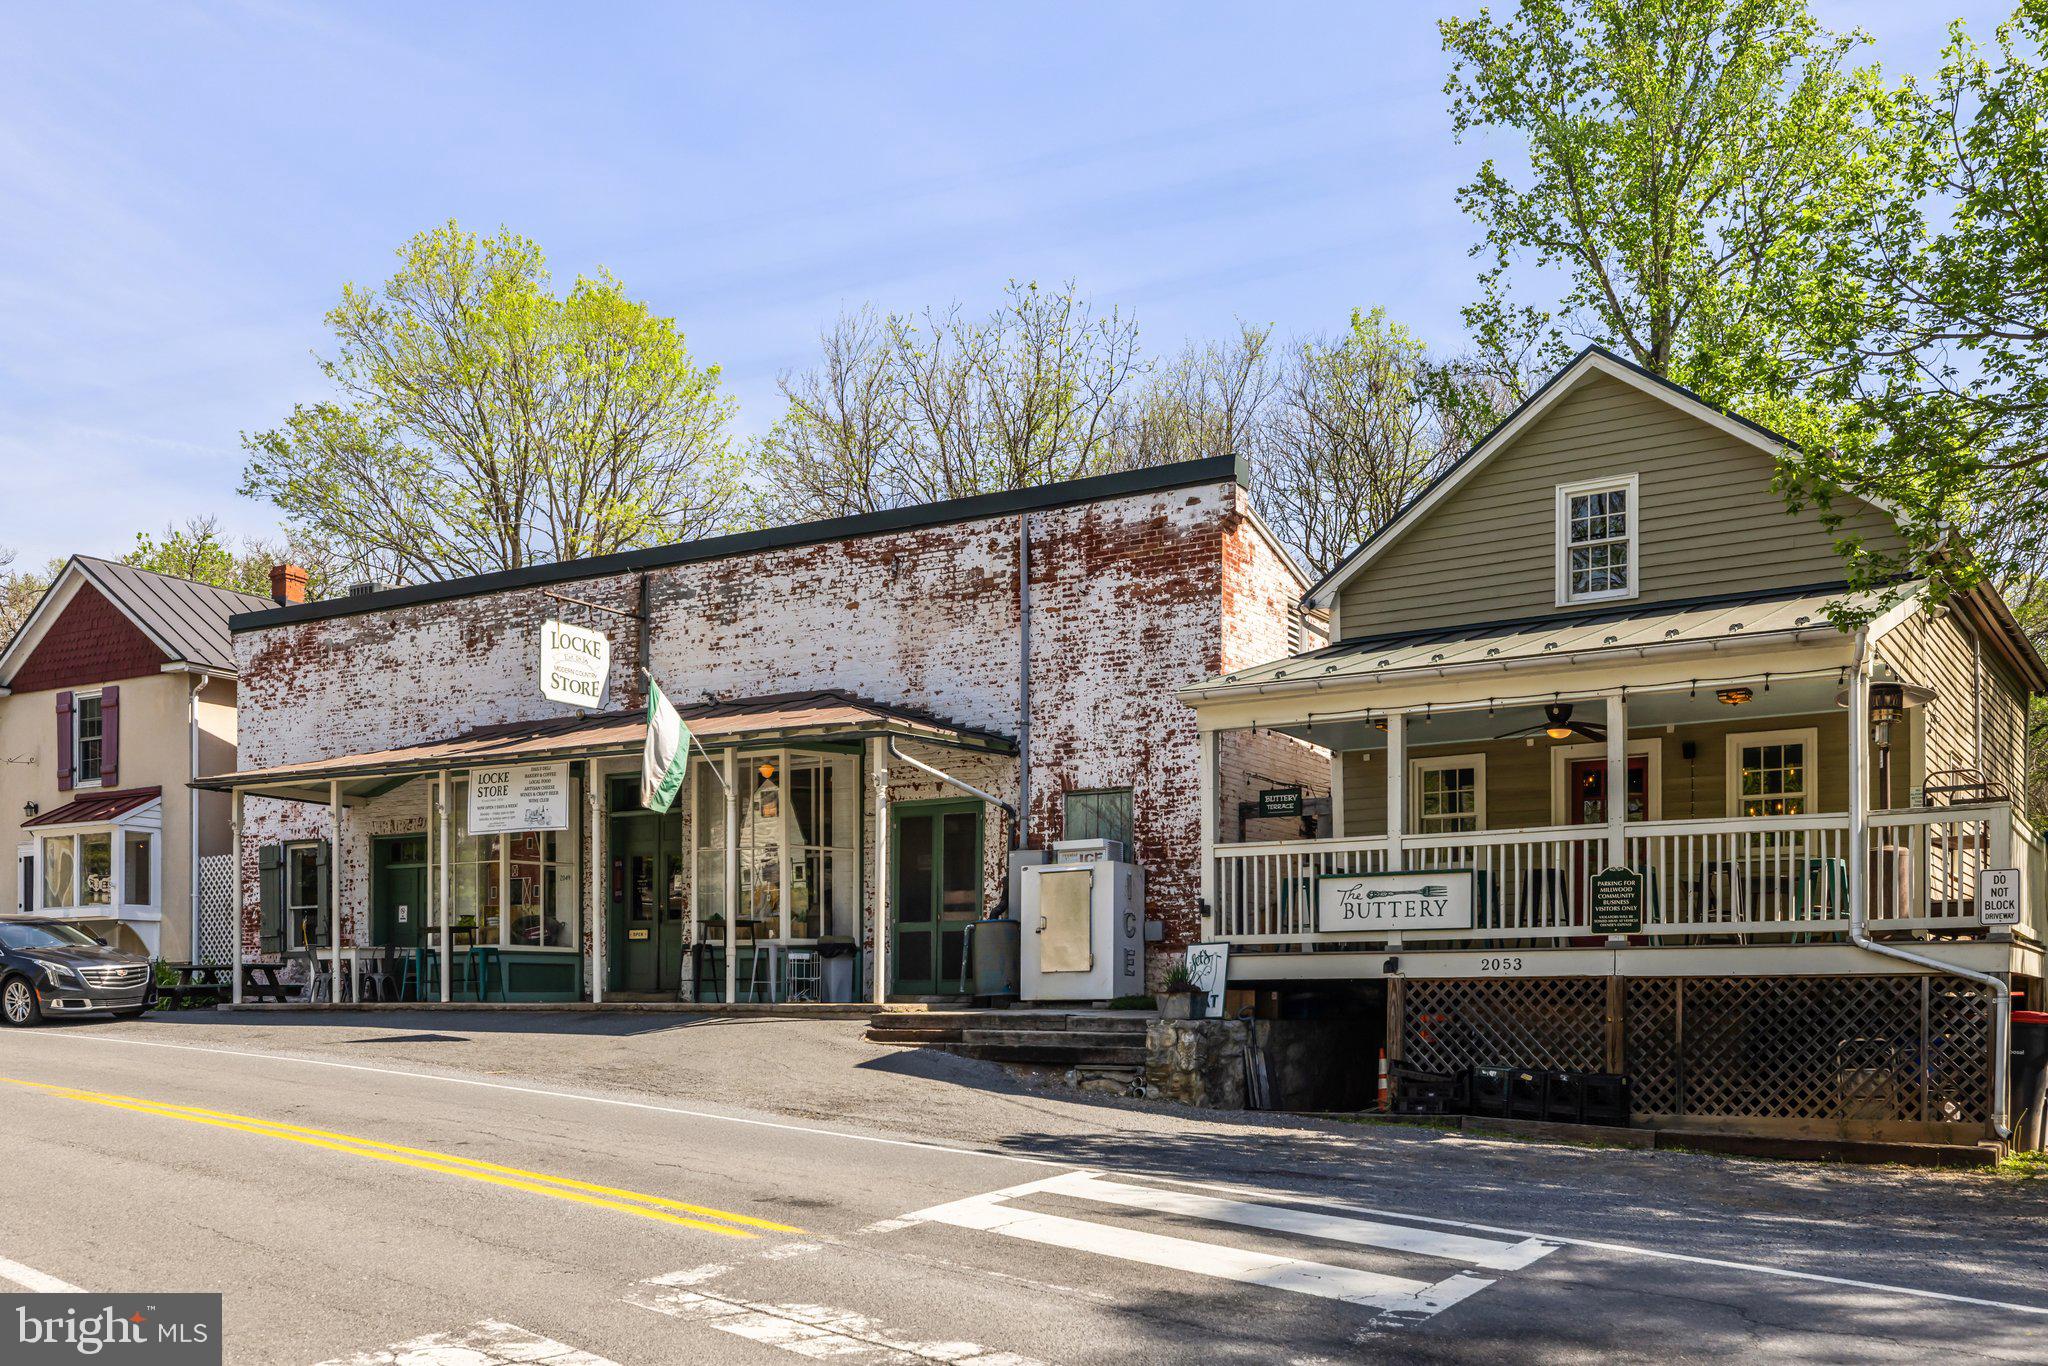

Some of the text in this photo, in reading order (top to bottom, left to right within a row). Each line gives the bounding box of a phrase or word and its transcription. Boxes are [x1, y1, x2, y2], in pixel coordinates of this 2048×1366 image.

[551, 631, 601, 660] LOCKE
[551, 672, 600, 697] STORE
[478, 772, 510, 784] LOCKE
[478, 785, 509, 797] STORE
[1265, 794, 1298, 802] BUTTERY
[1993, 875, 2006, 884] DO
[1337, 883, 1364, 906] The
[1991, 887, 2008, 897] NOT
[1343, 900, 1448, 919] BUTTERY
[1985, 900, 2015, 910] BLOCK
[1481, 958, 1522, 970] 2053
